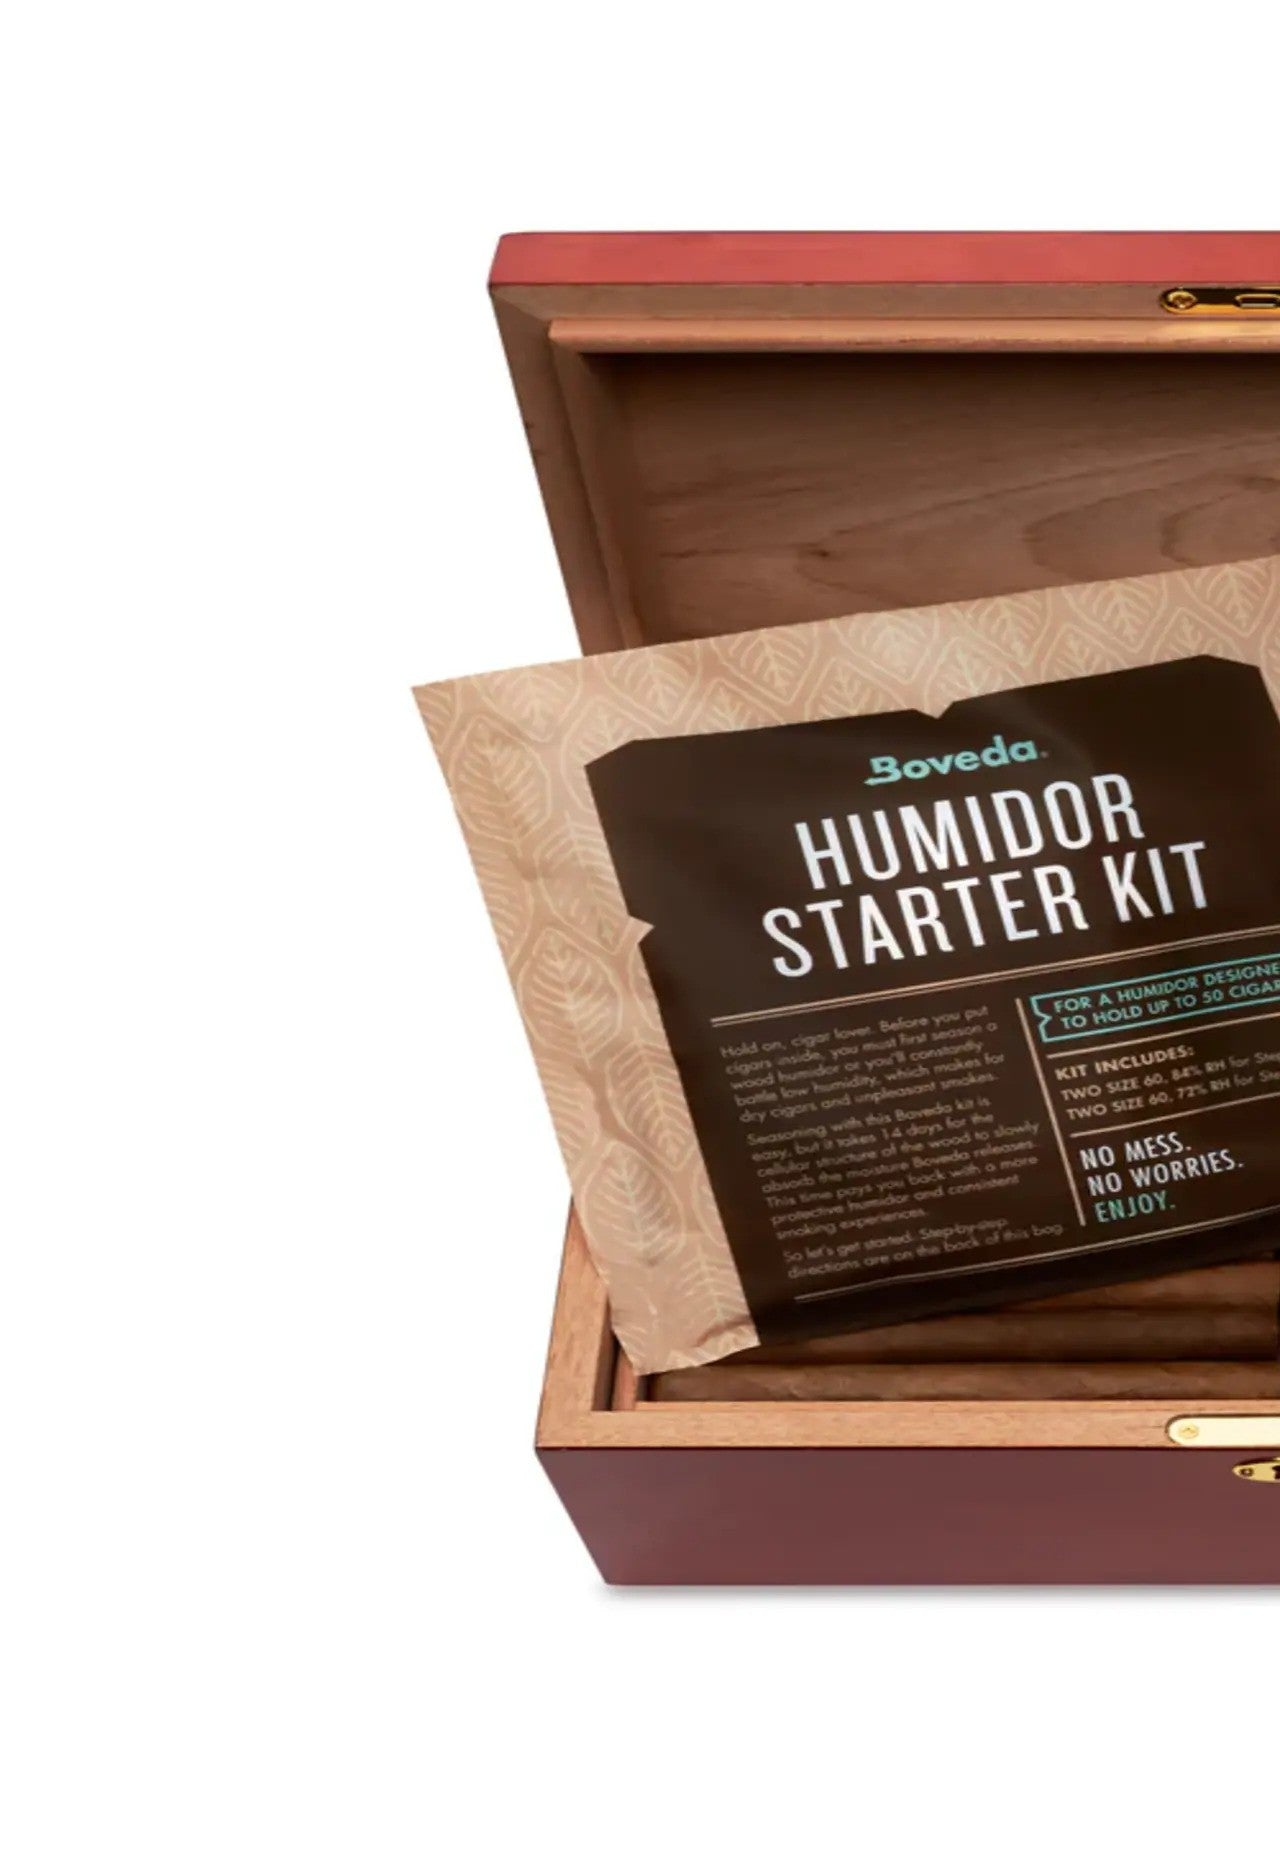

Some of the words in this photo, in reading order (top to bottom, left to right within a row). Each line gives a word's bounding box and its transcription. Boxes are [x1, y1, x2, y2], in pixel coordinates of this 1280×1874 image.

[864, 735, 1041, 786] Boveda
[794, 772, 1145, 890] HUMIDOR
[762, 864, 1090, 979] STARTER
[1101, 841, 1210, 924] KIT
[1054, 997, 1096, 1013] FOR
[1099, 993, 1113, 1006] A
[1117, 977, 1199, 1002] HUMIDOR
[1062, 1014, 1087, 1029] TO
[1093, 1005, 1143, 1025] HOLD
[1148, 999, 1169, 1015] UP
[1174, 995, 1197, 1008] TO
[1202, 989, 1224, 1004] 50
[721, 1042, 758, 1057] Hold
[791, 1033, 830, 1047] cigar
[880, 1018, 929, 1033] Before
[931, 1012, 960, 1027] you
[965, 1006, 988, 1021] put
[726, 1061, 772, 1075] cigars
[830, 1046, 859, 1061] you
[862, 1038, 897, 1051] must
[899, 1033, 927, 1045] first
[931, 1025, 982, 1040] season
[986, 1022, 998, 1032] a
[730, 1072, 775, 1089] wood
[777, 1063, 840, 1081] humidor
[844, 1062, 860, 1071] or
[780, 1087, 809, 1099] low
[884, 1066, 930, 1081] which
[933, 1058, 980, 1074] makes
[984, 1053, 1005, 1065] for
[1055, 1063, 1087, 1081] KIT
[1095, 1046, 1195, 1074] INCLUDES:
[1060, 1084, 1101, 1102] TWO
[1107, 1076, 1140, 1094] SIZE
[1172, 1065, 1202, 1080] 84%
[1205, 1057, 1226, 1074] RH
[1229, 1054, 1250, 1069] for
[740, 1109, 766, 1123] dry
[769, 1102, 818, 1118] cigars
[821, 1093, 850, 1108] and
[853, 1081, 936, 1104] unpleasant
[1065, 1103, 1108, 1120] TWO
[1112, 1095, 1145, 1113] SIZE
[1177, 1084, 1208, 1100] 72%
[1210, 1076, 1231, 1092] RH
[1234, 1073, 1254, 1087] for
[747, 1125, 828, 1146] Seasoning
[831, 1116, 863, 1131] with
[865, 1113, 892, 1126] this
[894, 1102, 953, 1121] Boveda
[955, 1098, 974, 1110] kit
[977, 1097, 991, 1107] is
[795, 1140, 820, 1155] but
[823, 1139, 834, 1150] it
[837, 1133, 876, 1147] takes
[881, 1127, 902, 1139] 14
[906, 1123, 944, 1137] days
[946, 1116, 966, 1129] for
[971, 1113, 994, 1125] the
[816, 1151, 877, 1168] structure
[881, 1142, 897, 1158] of
[900, 1142, 924, 1154] the
[927, 1132, 971, 1148] wood
[974, 1132, 989, 1141] to
[993, 1121, 1039, 1138] slowly
[762, 1174, 815, 1193] absorb
[846, 1161, 909, 1179] moisture
[912, 1149, 971, 1168] Boveda
[1080, 1145, 1116, 1170] NO
[1124, 1131, 1192, 1163] MESS.
[1086, 1173, 1122, 1197] NO
[1129, 1149, 1245, 1189] WORRIES.
[766, 1196, 797, 1208] This
[799, 1192, 834, 1203] time
[837, 1184, 873, 1200] pays
[876, 1181, 905, 1193] you
[908, 1168, 946, 1186] back
[949, 1163, 980, 1178] with
[984, 1162, 996, 1173] a
[1000, 1156, 1039, 1170] more
[771, 1205, 844, 1228] protective
[847, 1194, 909, 1211] humidor
[913, 1185, 944, 1201] and
[947, 1173, 1020, 1195] consistent
[1095, 1190, 1176, 1223] ENJOY.
[777, 1224, 836, 1240] smoking
[783, 1249, 803, 1262] So
[837, 1241, 860, 1257] get
[788, 1261, 860, 1279] directions
[863, 1256, 889, 1267] are
[893, 1250, 912, 1261] on
[916, 1243, 940, 1257] the
[943, 1235, 980, 1252] back
[985, 1230, 999, 1245] of
